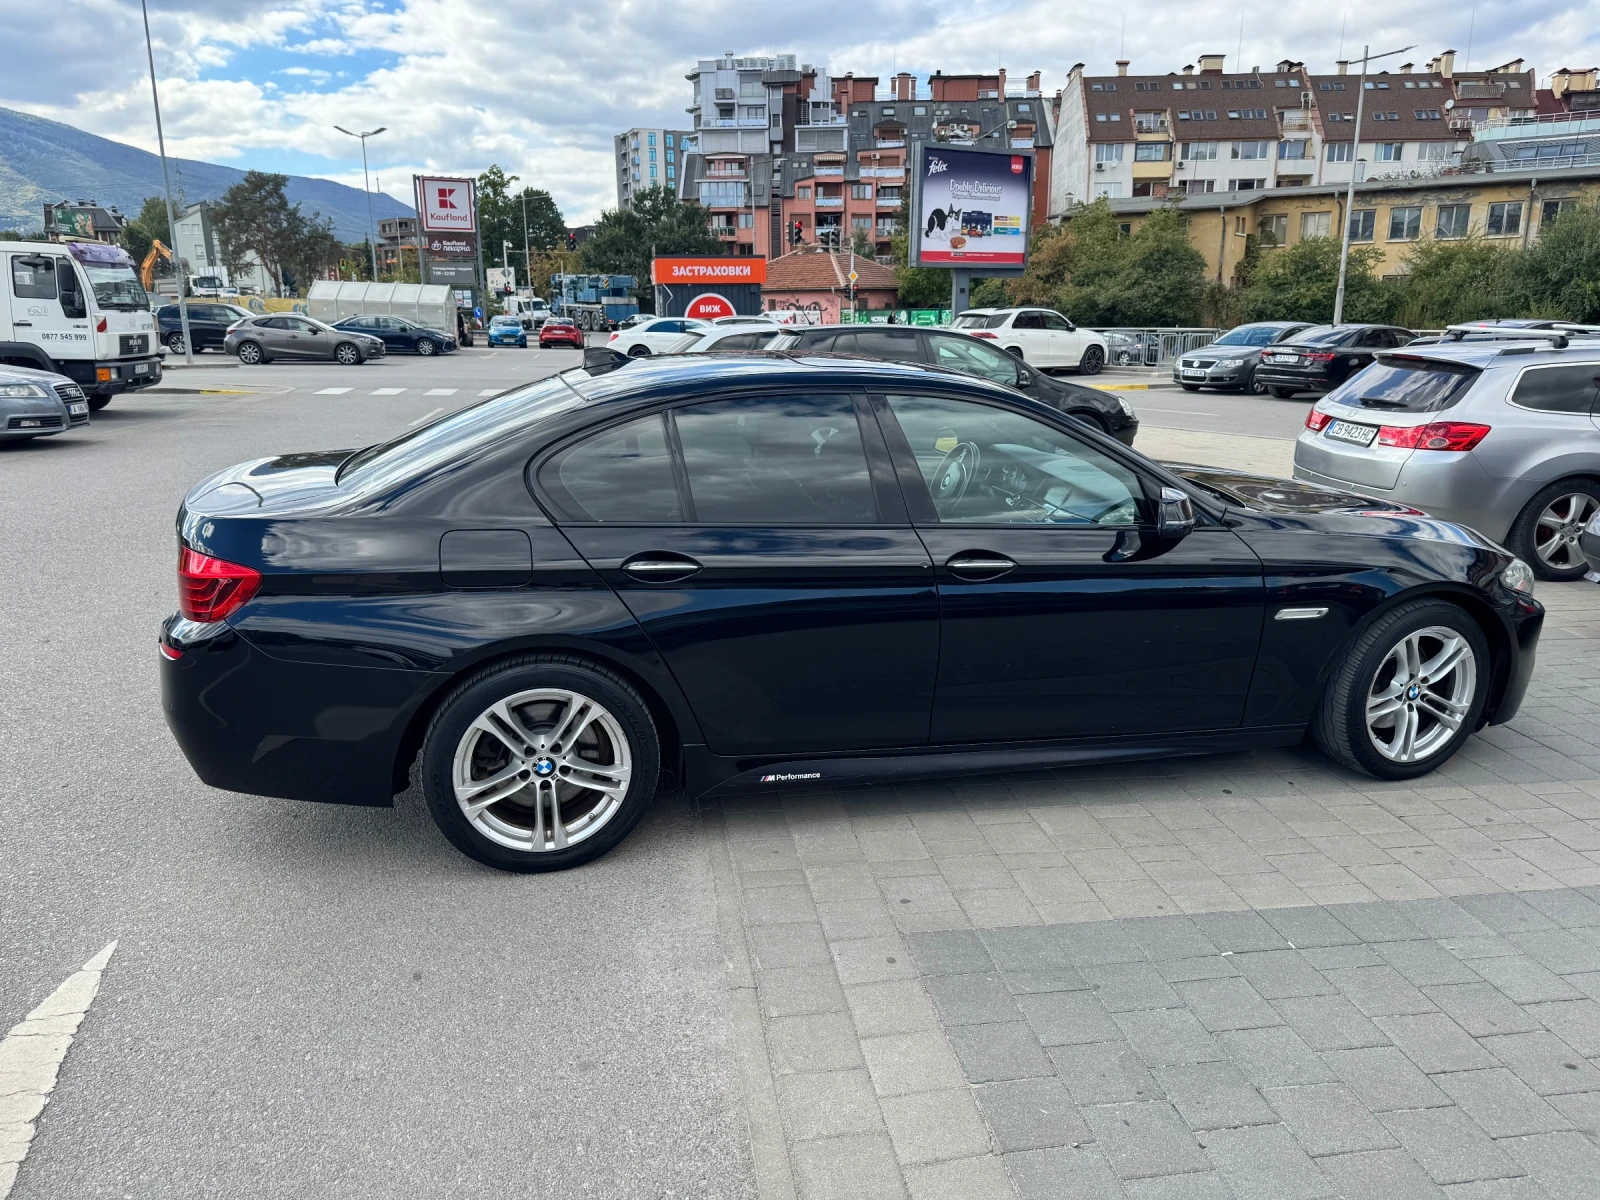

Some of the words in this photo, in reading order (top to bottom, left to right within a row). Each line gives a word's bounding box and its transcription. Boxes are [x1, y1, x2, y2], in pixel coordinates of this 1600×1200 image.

[949, 179, 973, 195] Doubly
[974, 180, 1002, 195] Delicious
[430, 212, 468, 222] Kaufland
[672, 265, 751, 277] ЗАСТРАХОВКИ
[699, 304, 721, 313] ВИЖ
[128, 338, 142, 346] MAN
[1342, 424, 1362, 439] 9423
[776, 772, 821, 781] Performance
